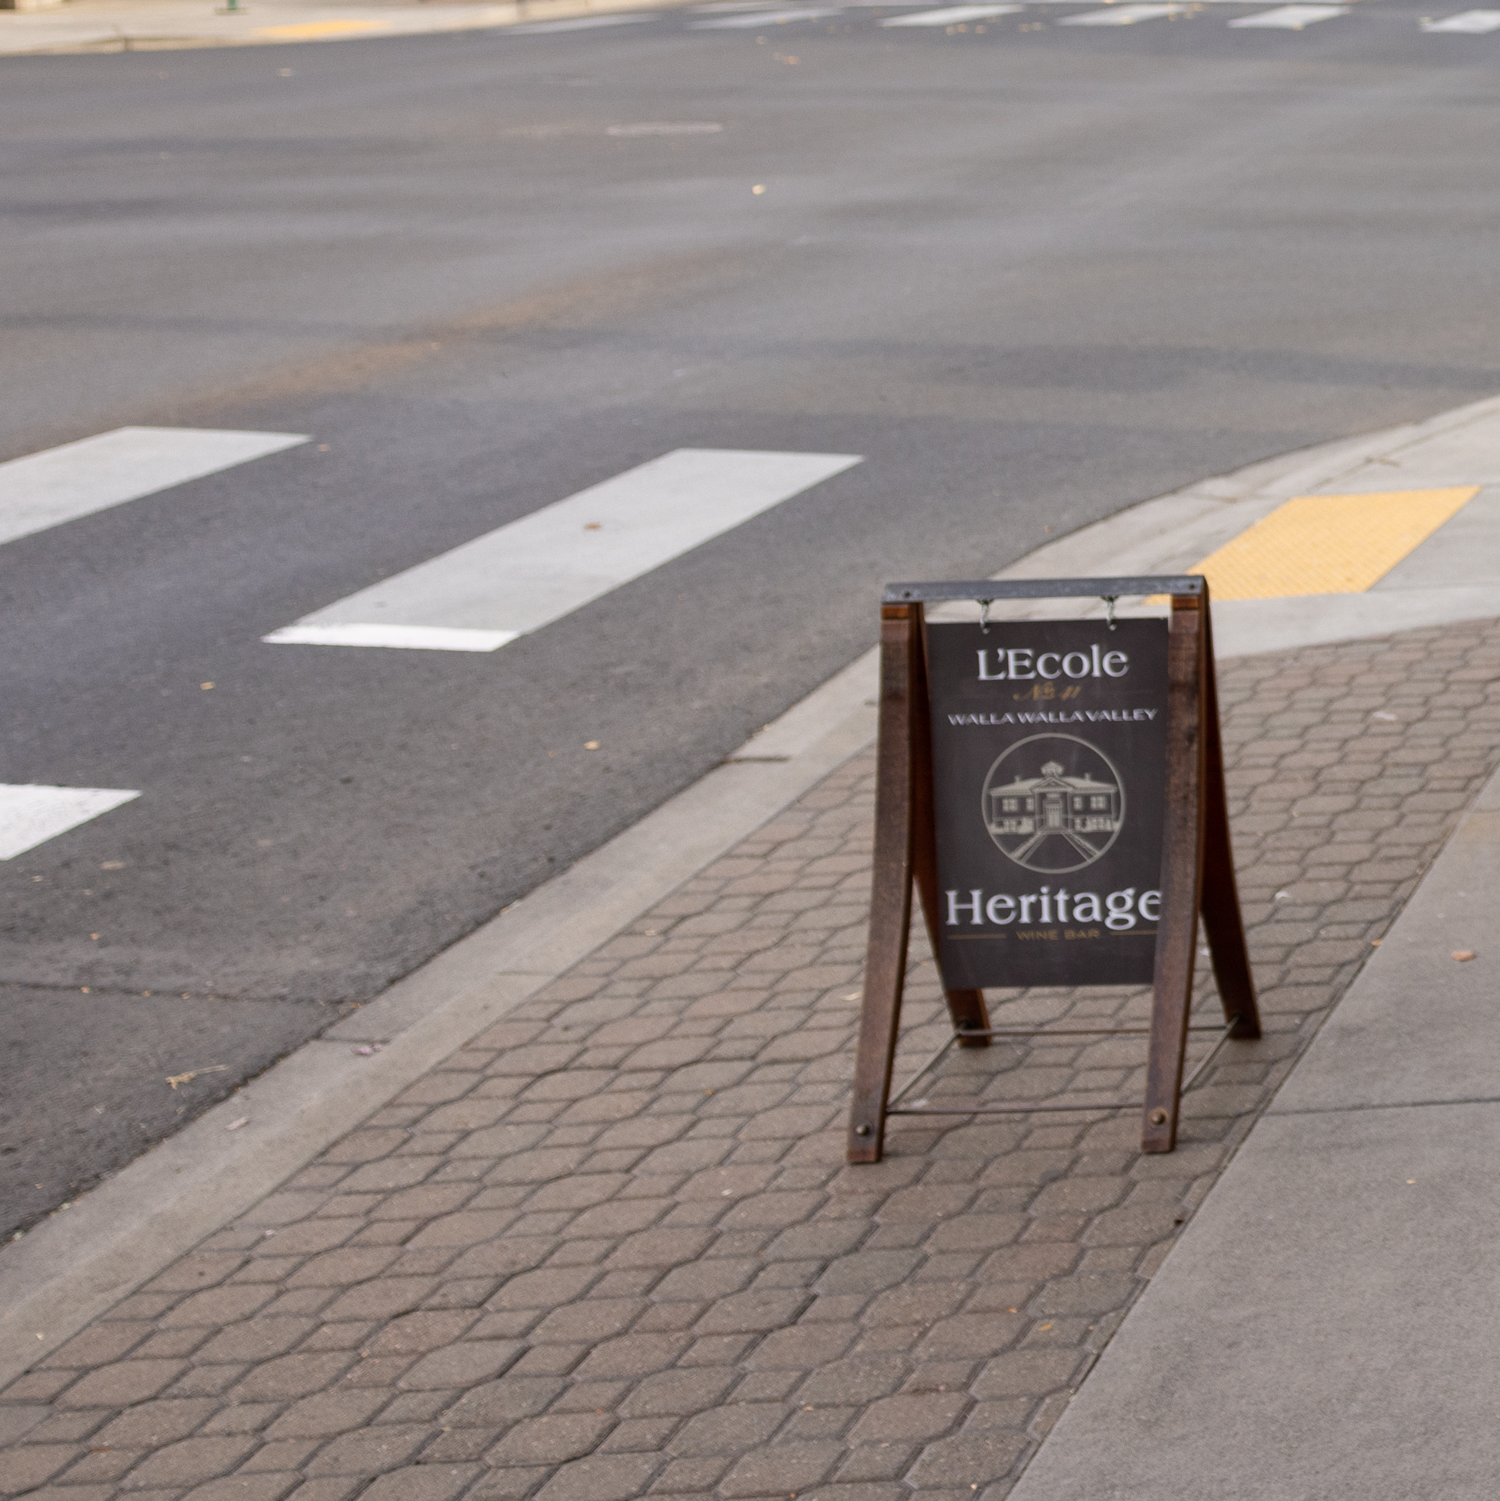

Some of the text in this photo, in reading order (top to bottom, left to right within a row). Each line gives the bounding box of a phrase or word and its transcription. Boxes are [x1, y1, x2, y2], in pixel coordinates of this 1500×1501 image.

[977, 643, 1130, 681] L'Ecole
[947, 707, 1158, 726] WALLA WALLA VALLEY
[945, 885, 1161, 932] Heritage
[1016, 928, 1100, 941] WINE BAR
